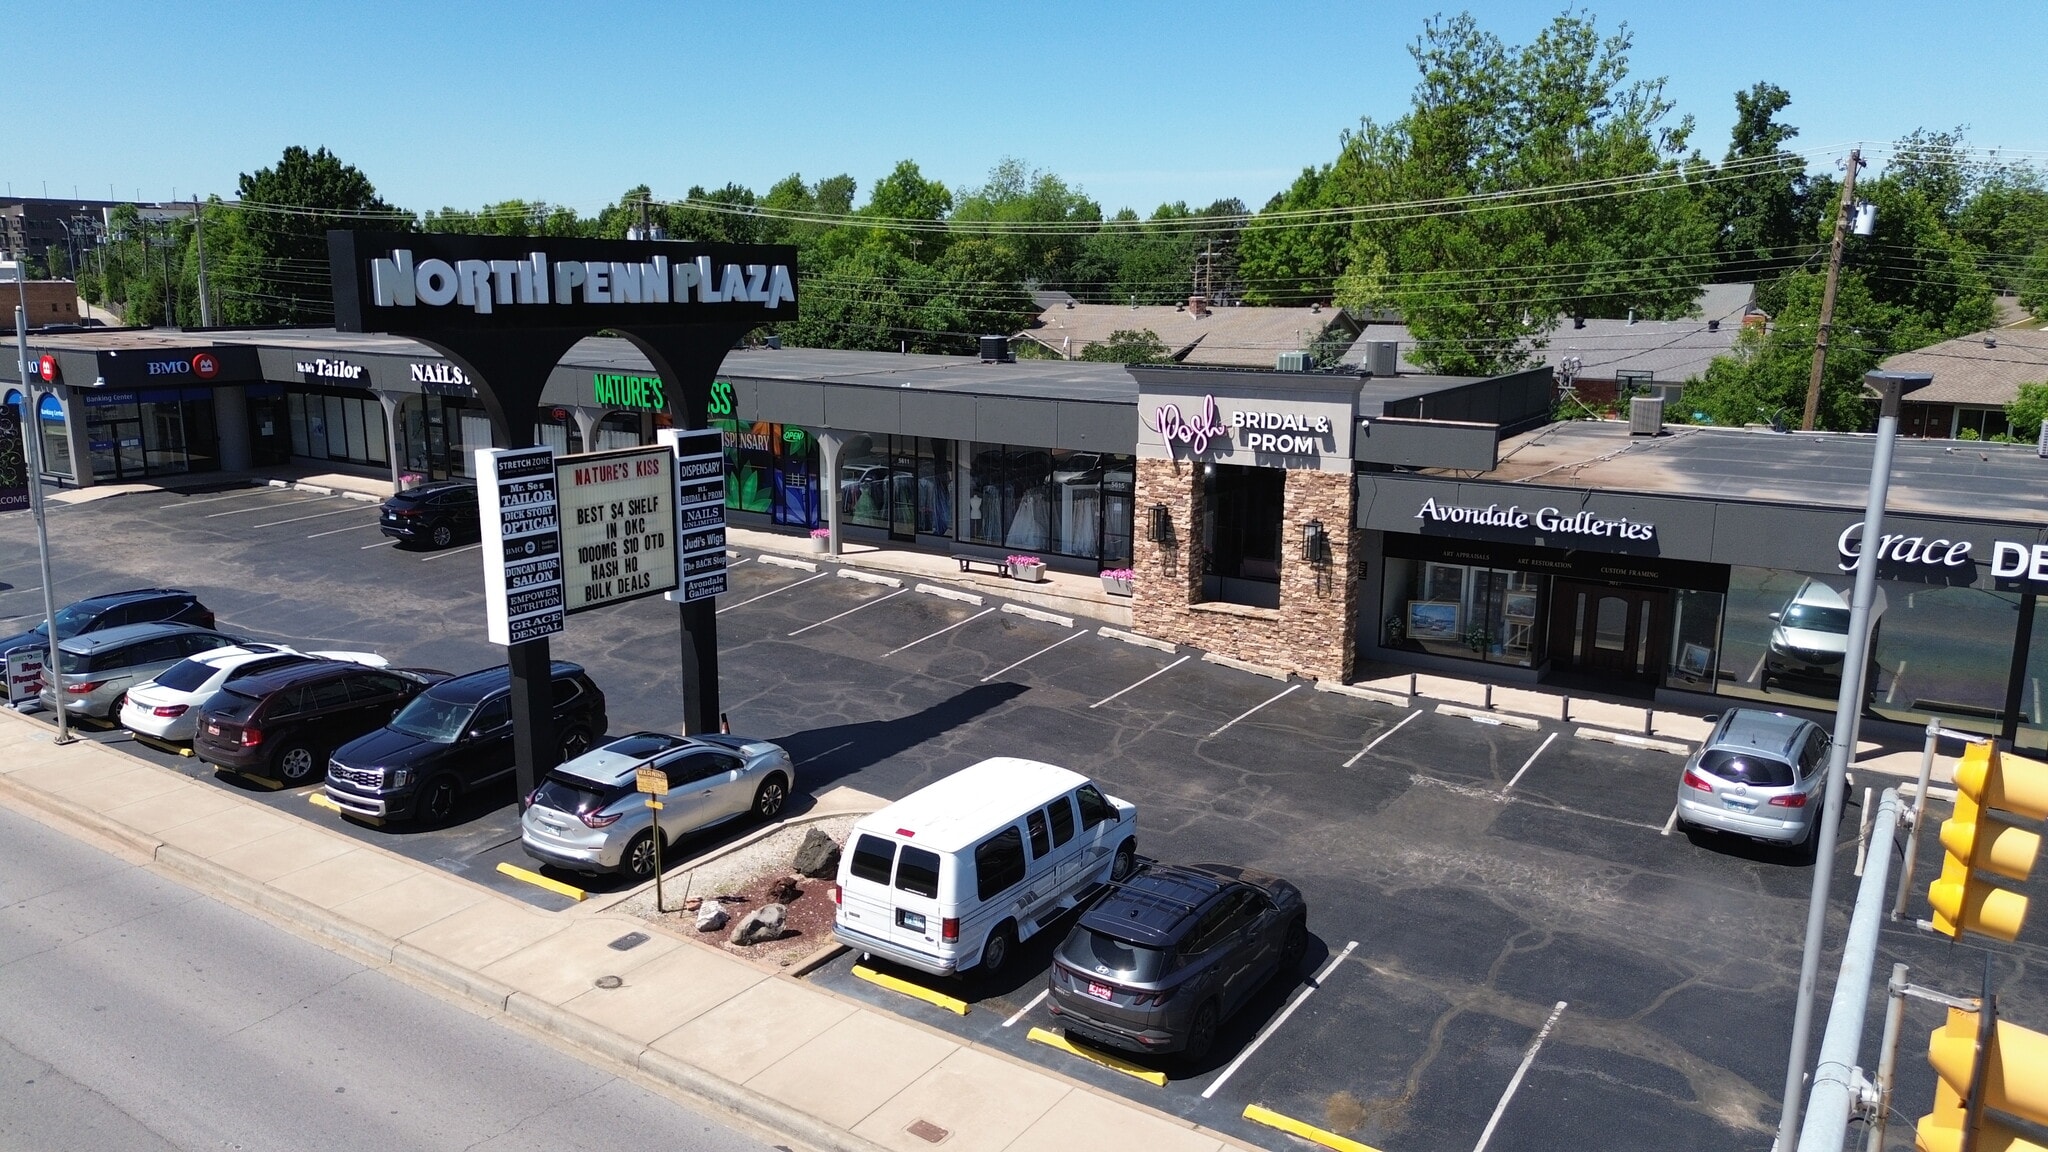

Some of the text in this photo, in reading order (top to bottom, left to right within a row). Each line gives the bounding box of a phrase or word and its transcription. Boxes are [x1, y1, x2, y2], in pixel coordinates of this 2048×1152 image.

[371, 249, 795, 314] NORTH PENN PLAZA
[147, 360, 190, 375] BMO
[316, 358, 361, 379] Tailor
[86, 394, 112, 403] Banking
[593, 373, 731, 414] NATURE'S SS
[1156, 394, 1226, 458] Posh
[1232, 410, 1329, 433] BRIDAL &
[1248, 432, 1313, 455] PROM
[498, 458, 532, 470] STRETCH
[532, 456, 550, 466] ZONE
[575, 458, 660, 486] NATURE'S KISS
[681, 461, 720, 478] DISPENSARY
[510, 484, 525, 493] Mr.
[707, 490, 723, 500] PROM
[0, 494, 28, 505] COME
[501, 490, 553, 507] TAILOR
[504, 506, 552, 521] DICK STORY
[577, 505, 604, 525] BEST
[628, 496, 659, 516] SHELF
[686, 507, 719, 521] NAILS
[1413, 497, 1654, 541] Avondale Galleries
[502, 515, 557, 534] OPTICAL
[606, 517, 646, 540] IN OKC
[683, 517, 723, 528] UNLIMITED
[578, 541, 617, 564] 1000MG
[644, 532, 664, 551] OTD
[684, 533, 724, 550] Judi's Wigs
[1838, 522, 1972, 571] Grace
[505, 547, 523, 556] BMO
[505, 559, 559, 578] DUNCAN BROS.
[591, 556, 639, 581] HASH HQ
[684, 562, 695, 571] The
[695, 557, 713, 569] BACK
[1531, 559, 1573, 569] RESTORATION
[1600, 566, 1659, 578] CUSTOM FRAMING
[512, 570, 554, 588] SALON
[585, 572, 651, 602] BULK DEALS
[688, 575, 724, 590] Avondale
[510, 587, 559, 606] EMPOWER
[688, 584, 724, 598] Galleries
[509, 596, 560, 616] NUTRITION
[511, 612, 561, 631] GRACE
[511, 622, 562, 641] DENTAL
